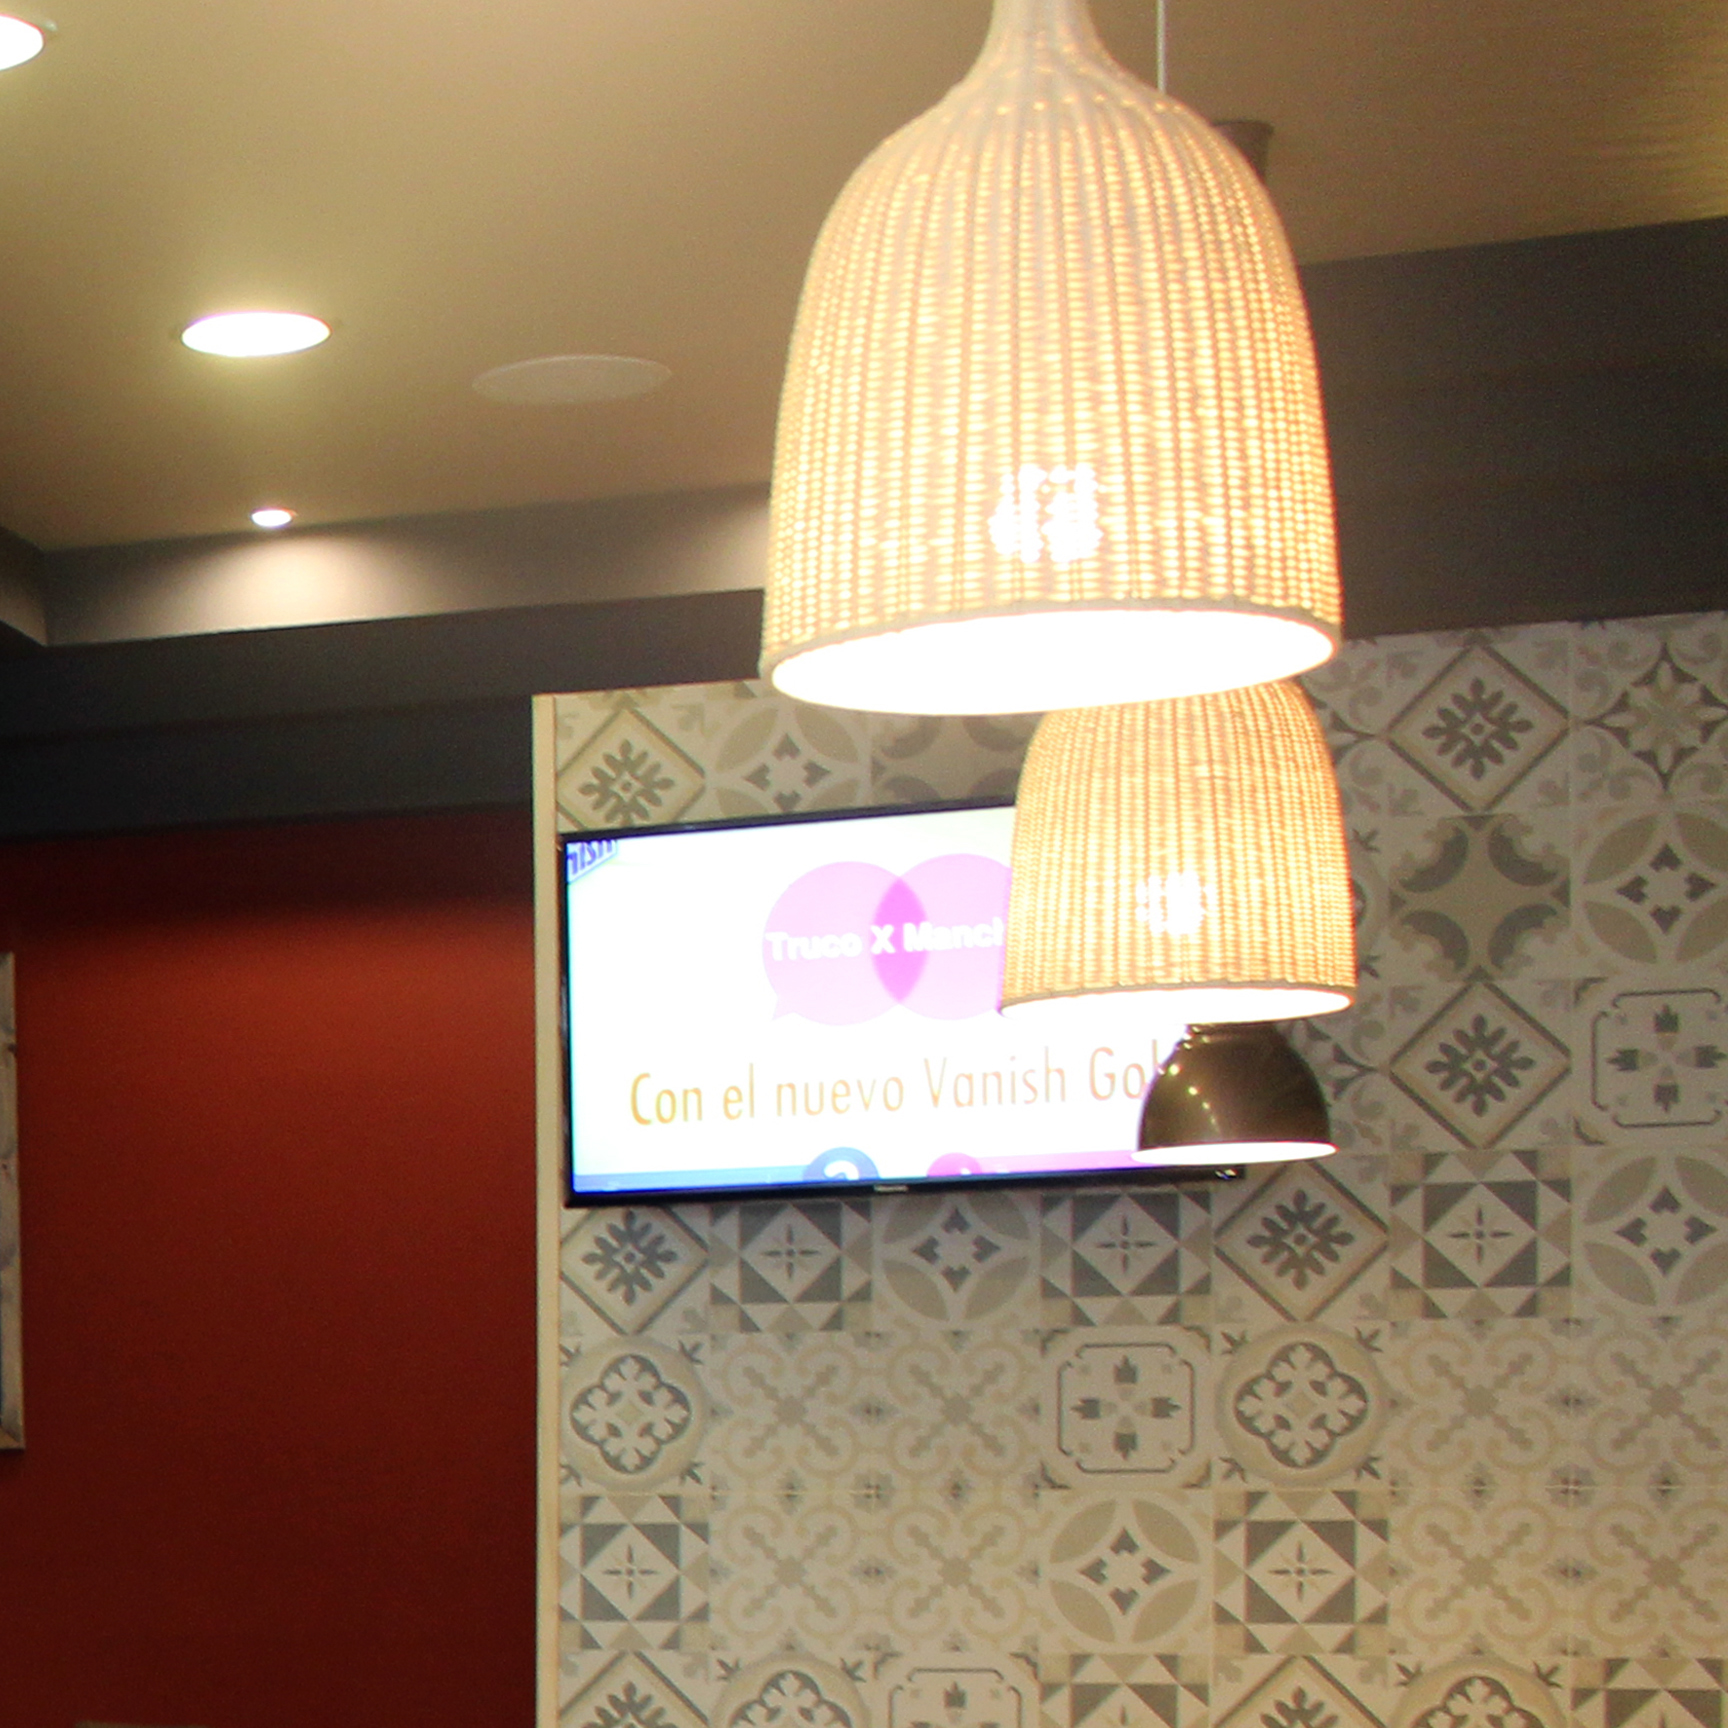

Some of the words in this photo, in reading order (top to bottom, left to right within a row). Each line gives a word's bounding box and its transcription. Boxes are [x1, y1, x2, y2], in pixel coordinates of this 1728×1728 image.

[765, 931, 864, 962] Truco
[871, 924, 895, 954] X
[630, 1071, 703, 1126] Con
[722, 1063, 756, 1120] el
[775, 1074, 905, 1118] nuevo
[922, 1045, 1067, 1109] Vanish
